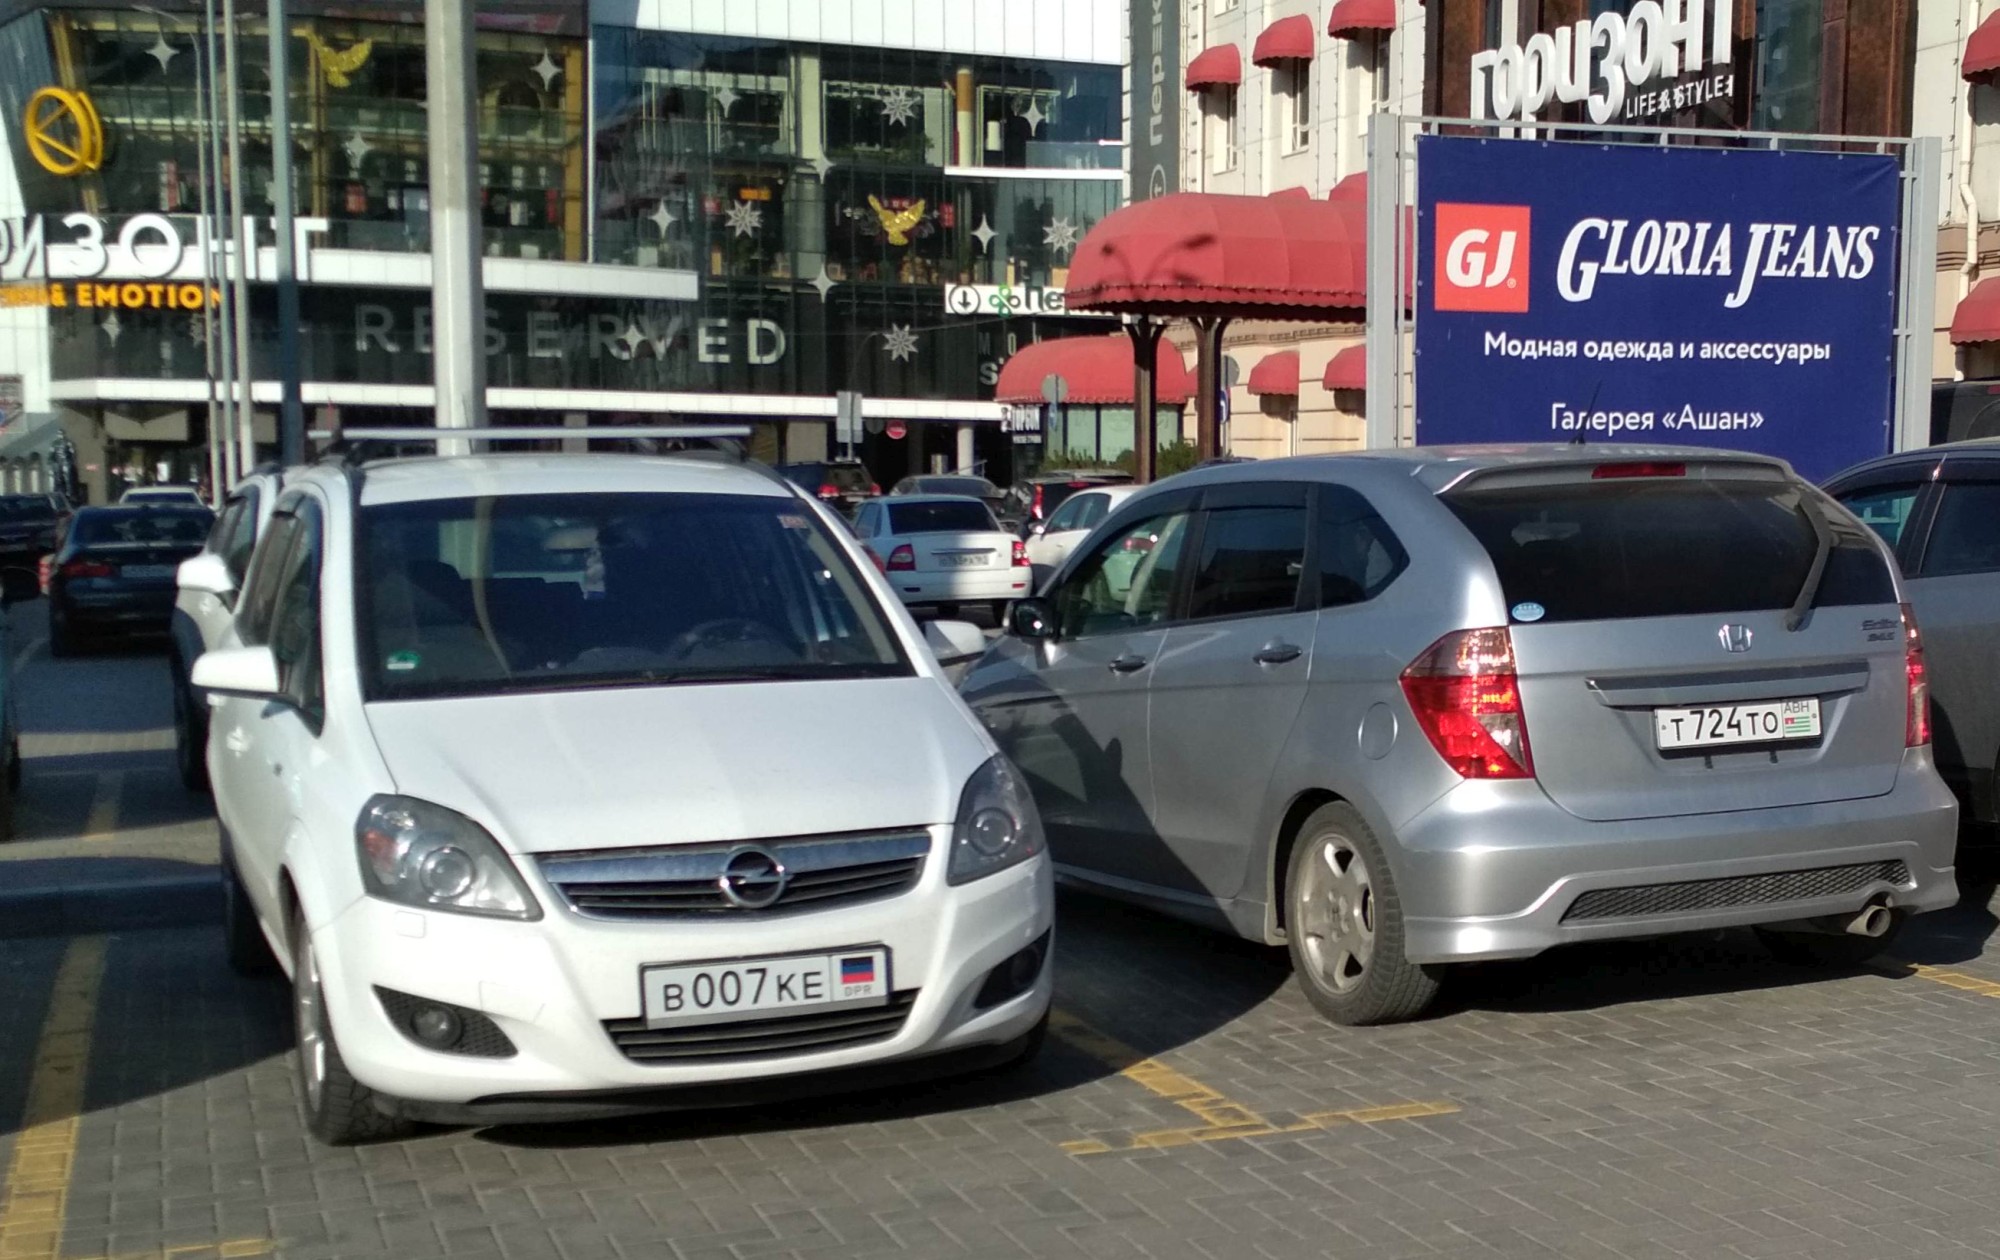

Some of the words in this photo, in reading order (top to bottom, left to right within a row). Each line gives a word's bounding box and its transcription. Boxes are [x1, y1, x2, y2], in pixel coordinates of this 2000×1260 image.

[1556, 217, 1732, 302] GLORIA
[1724, 223, 1880, 308] JEANS
[355, 303, 786, 365] RESERVED
[1484, 331, 1577, 359] Модная
[1583, 340, 1673, 361] одежда
[1680, 342, 1694, 358] и
[1700, 342, 1831, 365] аксессуары
[1551, 403, 1654, 436] Галерея
[1662, 404, 1764, 430] «Ашан»
[844, 984, 872, 997] DPR
